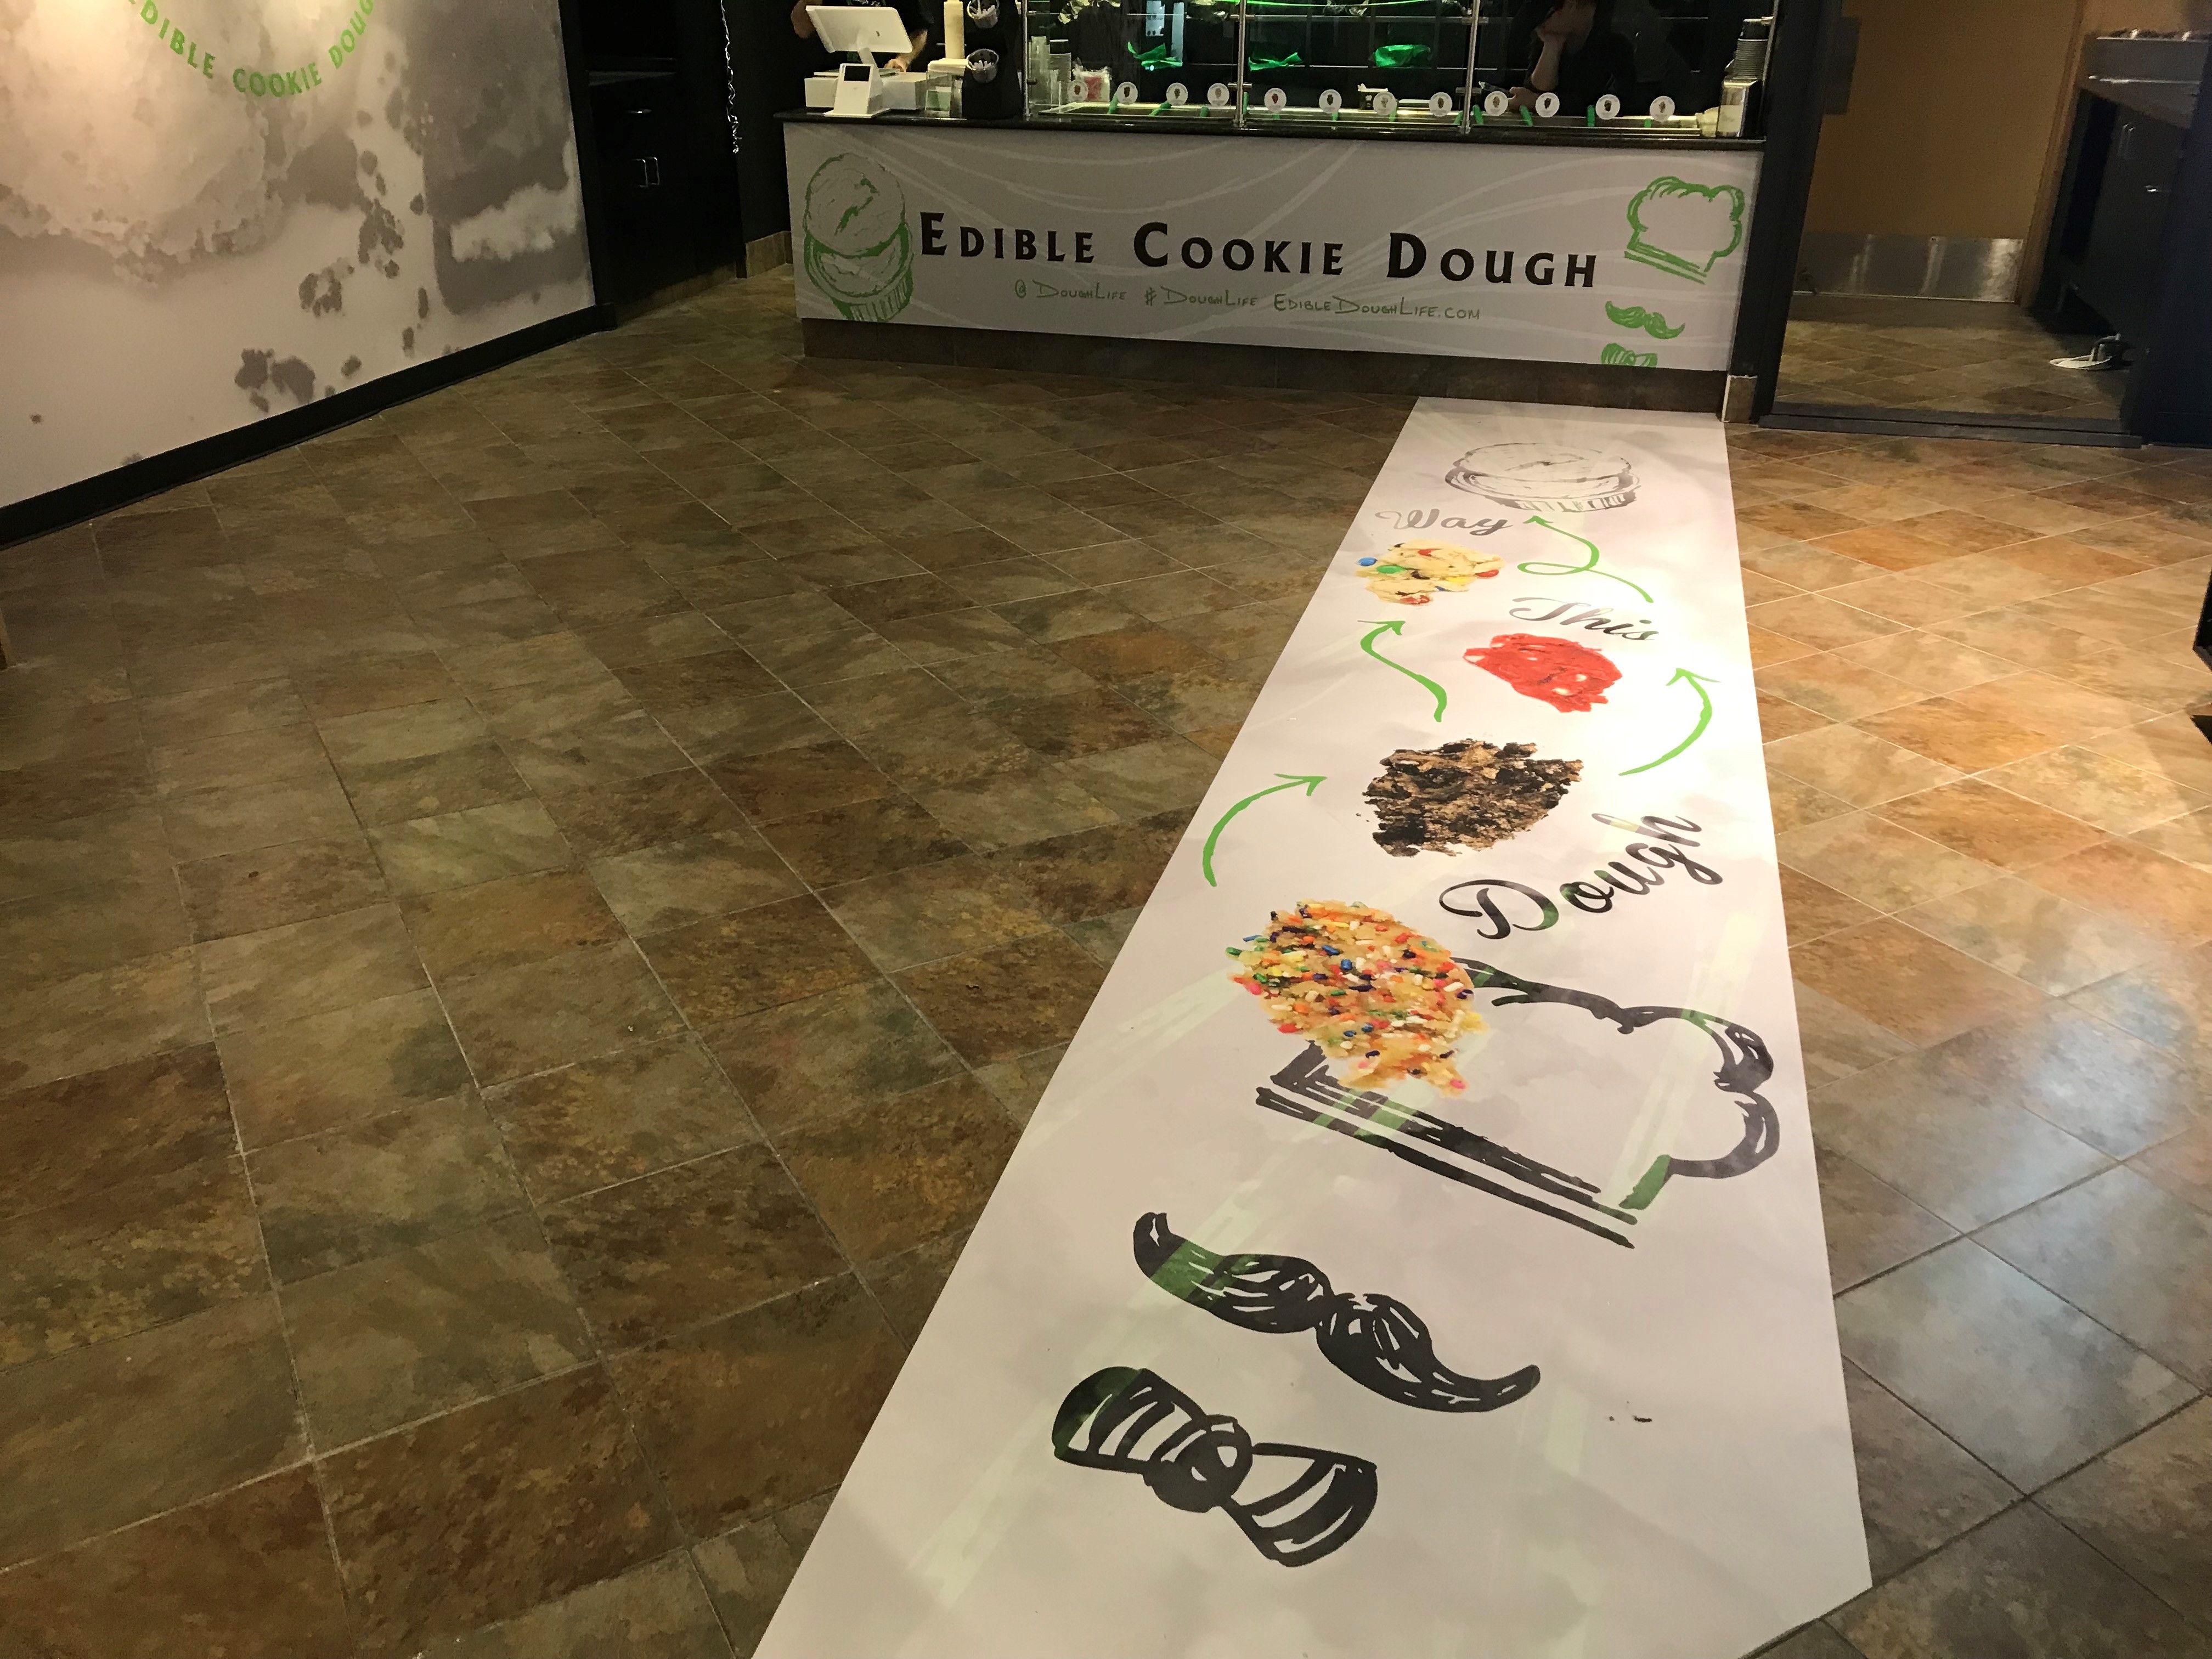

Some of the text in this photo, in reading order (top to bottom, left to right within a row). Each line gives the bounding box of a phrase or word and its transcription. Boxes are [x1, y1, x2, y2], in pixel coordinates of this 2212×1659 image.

[129, 0, 216, 78] DIBLE
[233, 62, 321, 97] COOKIE
[919, 211, 1598, 287] EDIBLE COOKIE DOUGH
[1273, 293, 1480, 319] EDIBLEDOUGHLIFE.COM
[1374, 507, 1514, 536] Way
[1508, 596, 1660, 641] This
[1439, 812, 1724, 940] Dough
